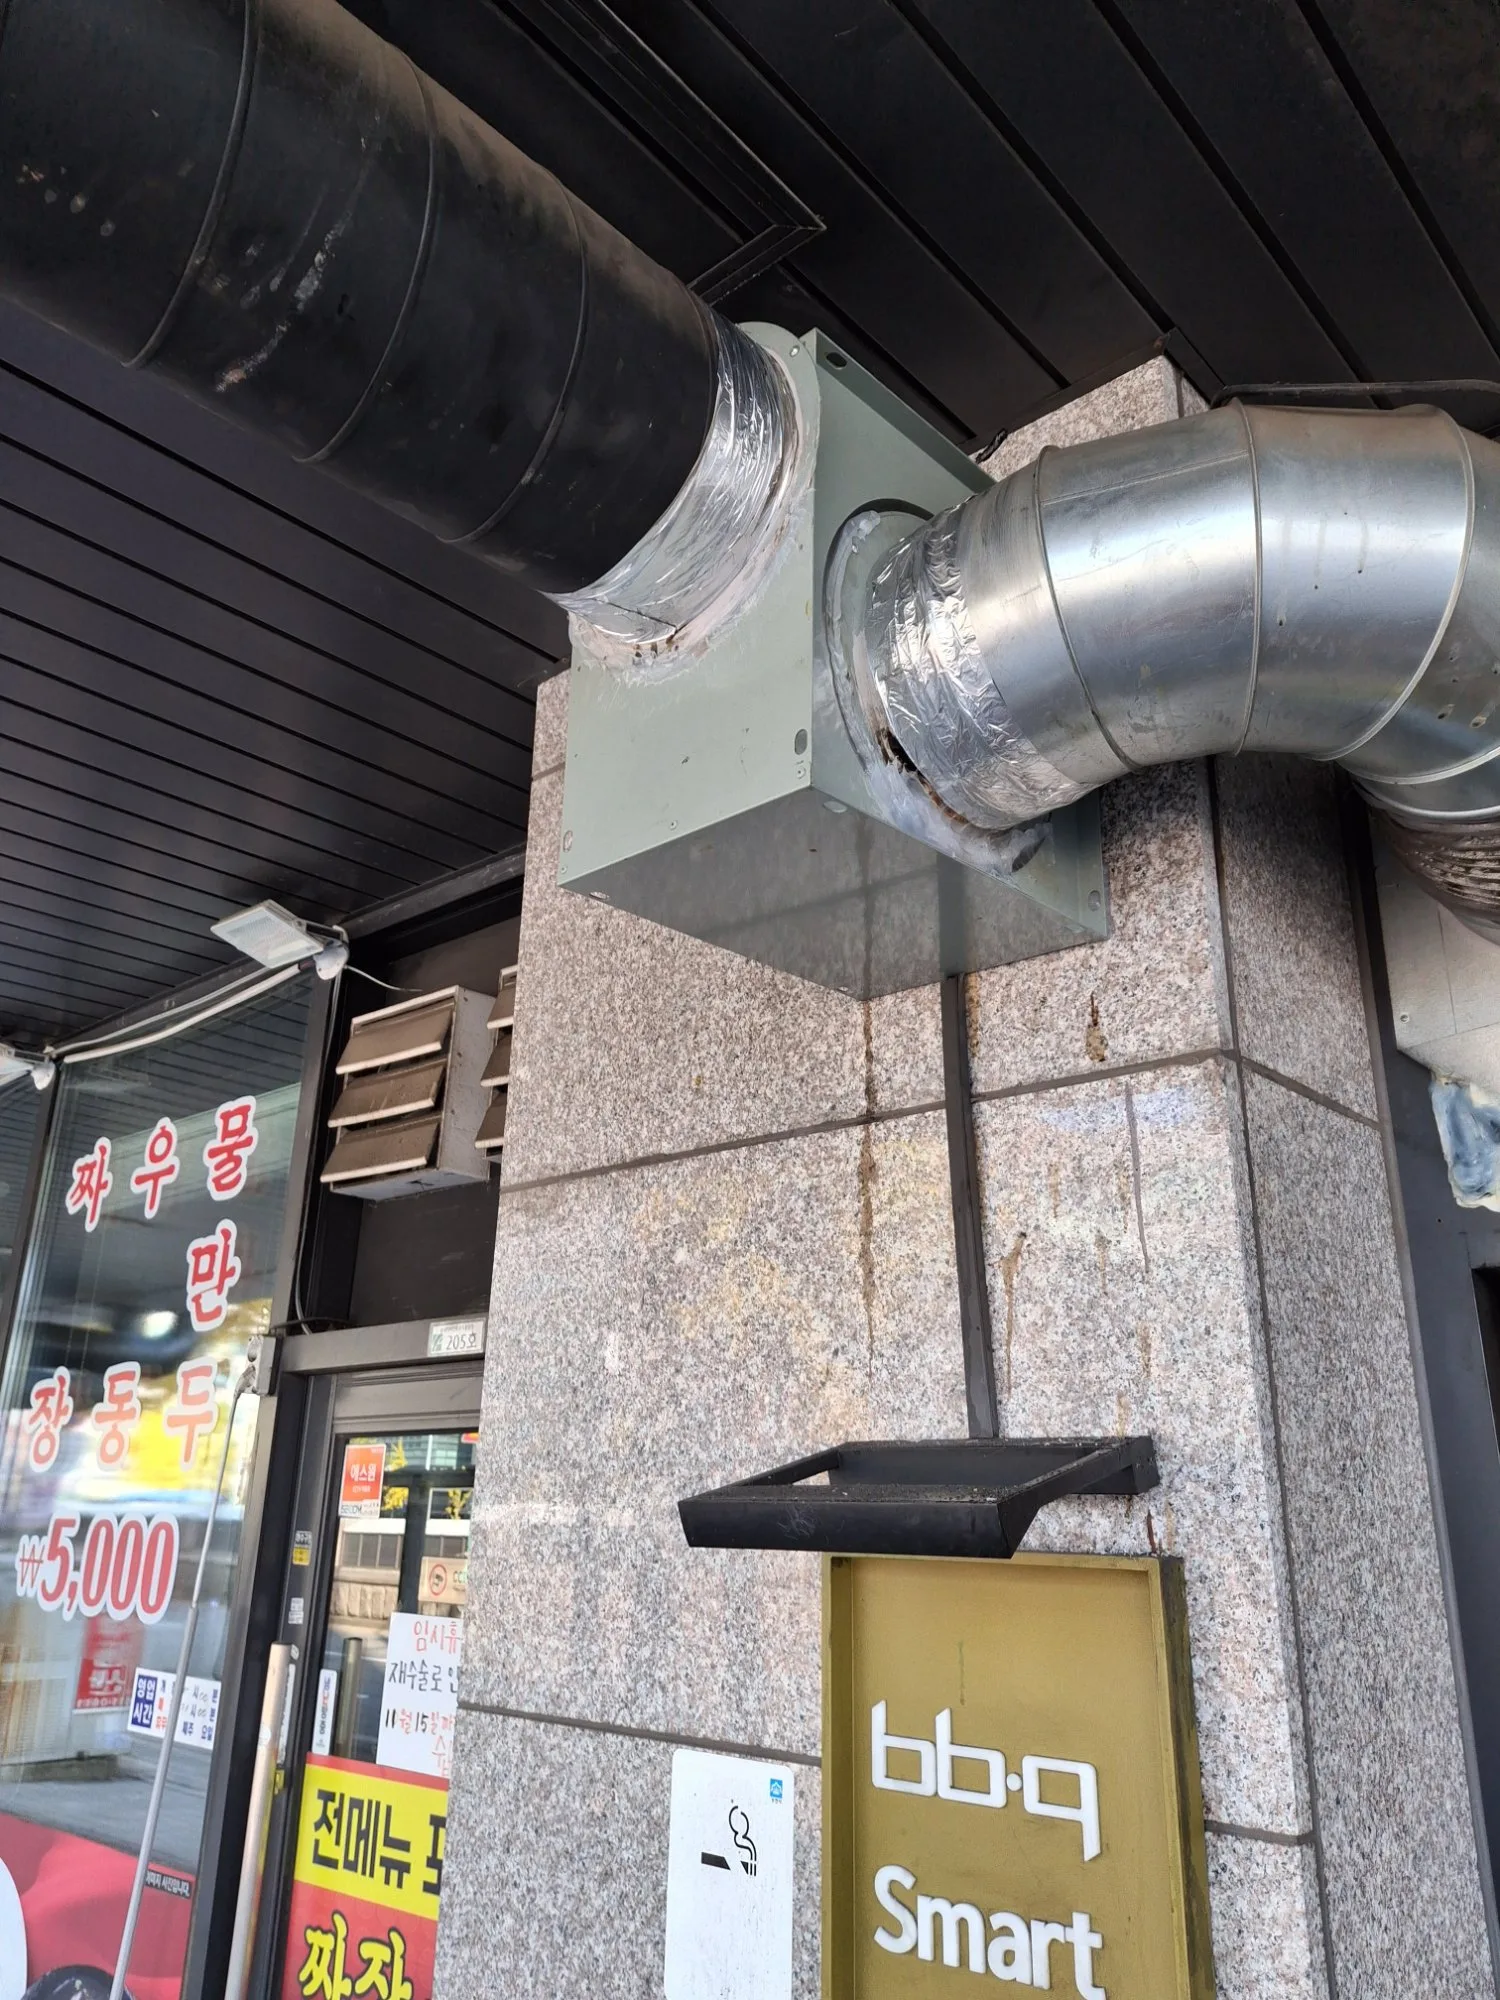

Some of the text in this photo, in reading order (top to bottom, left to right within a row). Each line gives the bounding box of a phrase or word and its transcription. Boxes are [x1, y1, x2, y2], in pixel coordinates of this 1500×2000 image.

[446, 1331, 477, 1350] 205호
[19, 1517, 175, 1614] ₩5,000
[132, 1702, 152, 1726] 시간
[136, 1677, 155, 1701] 영업
[312, 1788, 412, 1890] 전메뉴
[873, 1864, 1106, 2000] Smart
